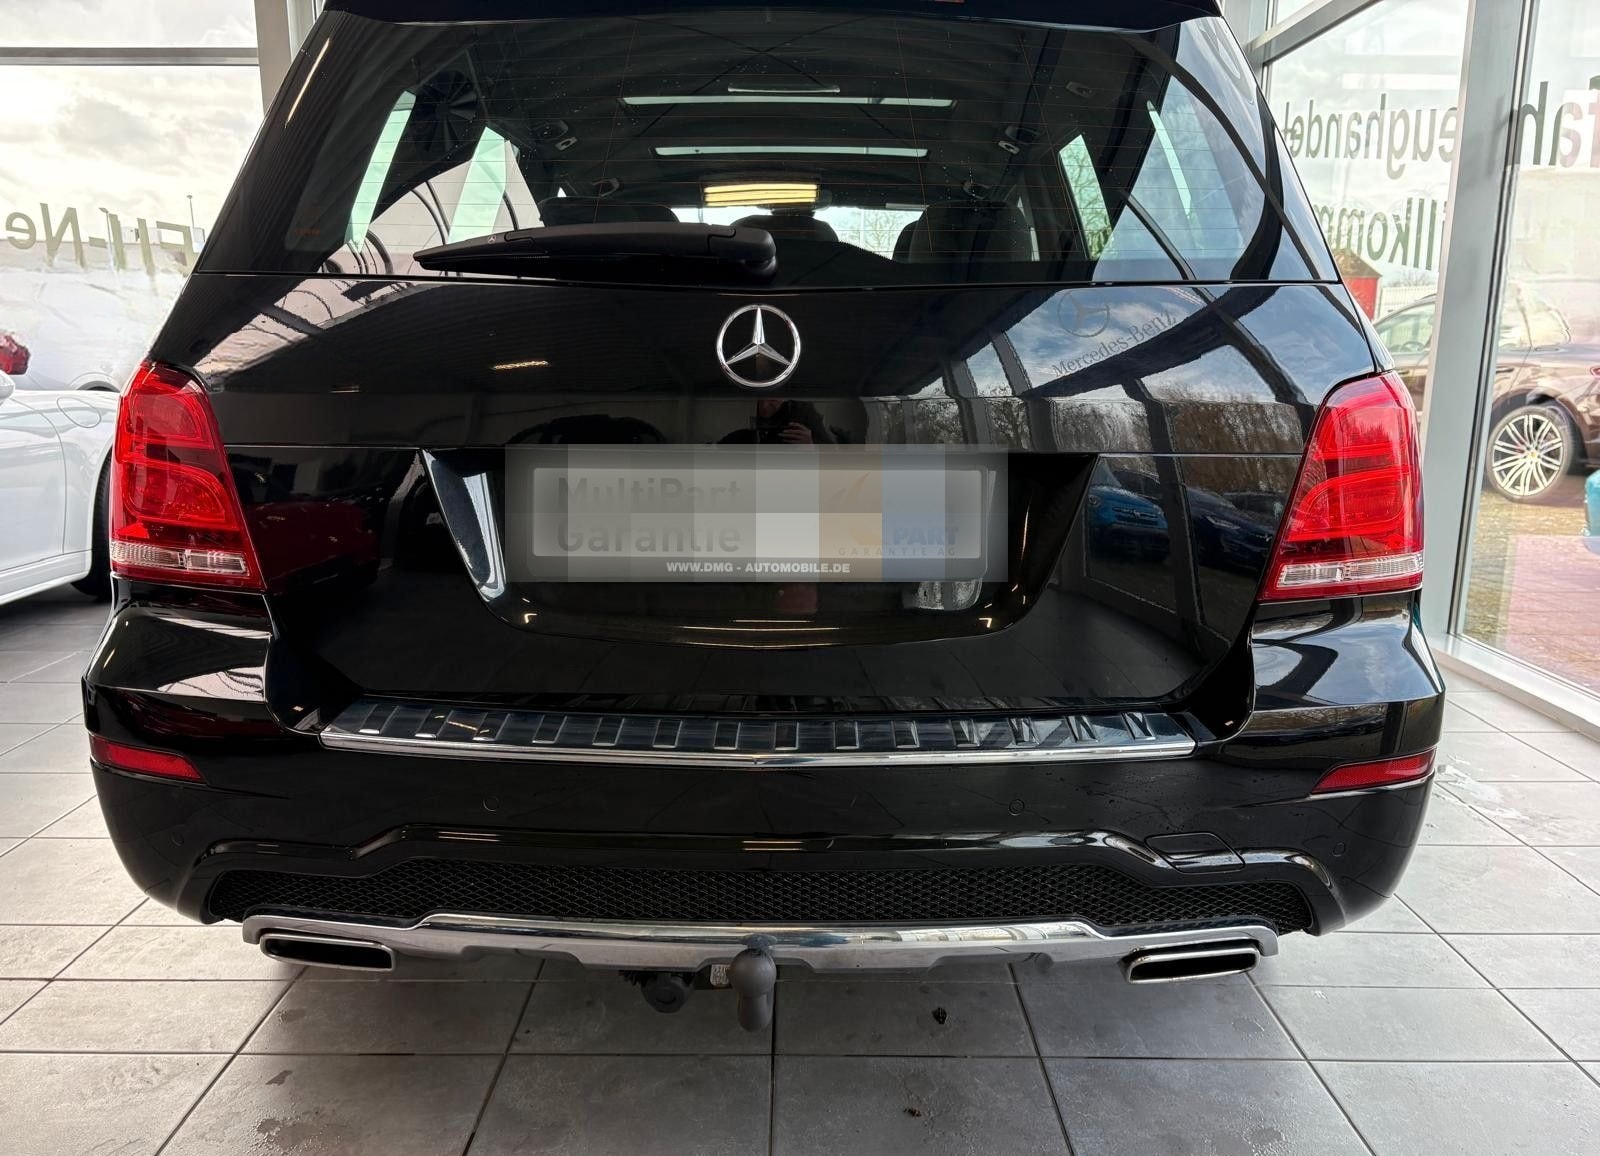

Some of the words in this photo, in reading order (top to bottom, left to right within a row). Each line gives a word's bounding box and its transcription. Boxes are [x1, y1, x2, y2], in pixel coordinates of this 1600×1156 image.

[1051, 309, 1177, 378] Mercedes-Benz
[557, 476, 741, 510] MultiPart
[557, 519, 741, 553] Garantie
[892, 527, 960, 545] PART
[838, 546, 928, 556] GARANTIE
[936, 546, 957, 556] AG
[666, 562, 734, 573] WWW.DMG
[745, 562, 851, 574] AUTOMOBILE.DE
